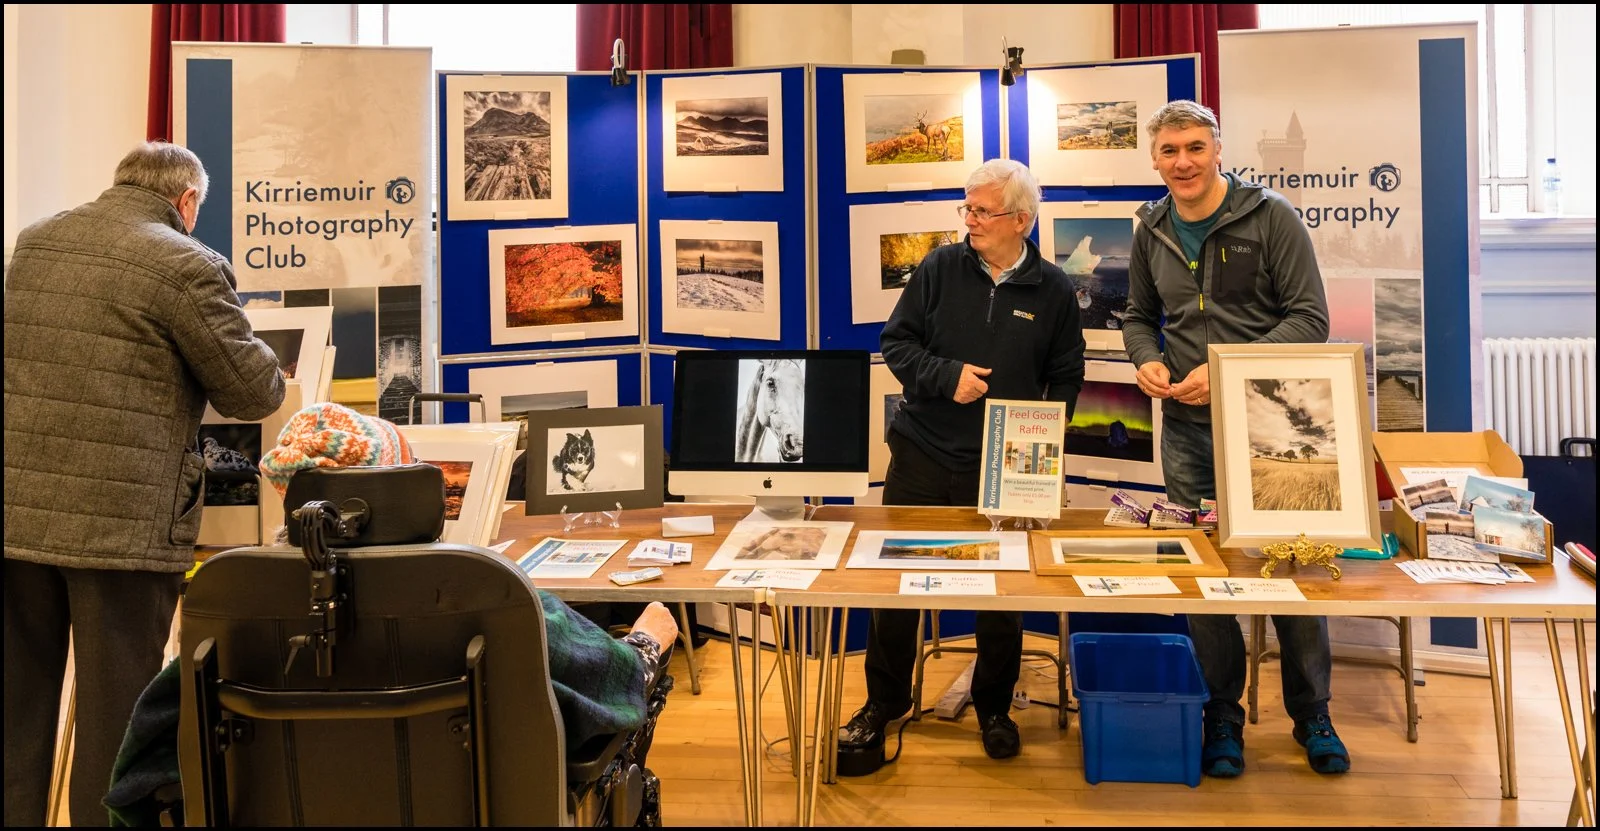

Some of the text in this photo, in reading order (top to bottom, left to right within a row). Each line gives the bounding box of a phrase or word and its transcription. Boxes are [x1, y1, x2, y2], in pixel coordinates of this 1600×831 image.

[246, 180, 375, 203] Kirriemuir
[246, 210, 414, 240] Photography
[1294, 198, 1400, 229] graphy
[245, 245, 306, 269] Club
[1009, 410, 1059, 420] Feel Good
[1019, 425, 1048, 435] Raffle
[989, 409, 1002, 504] Kirriemuir Photography Club
